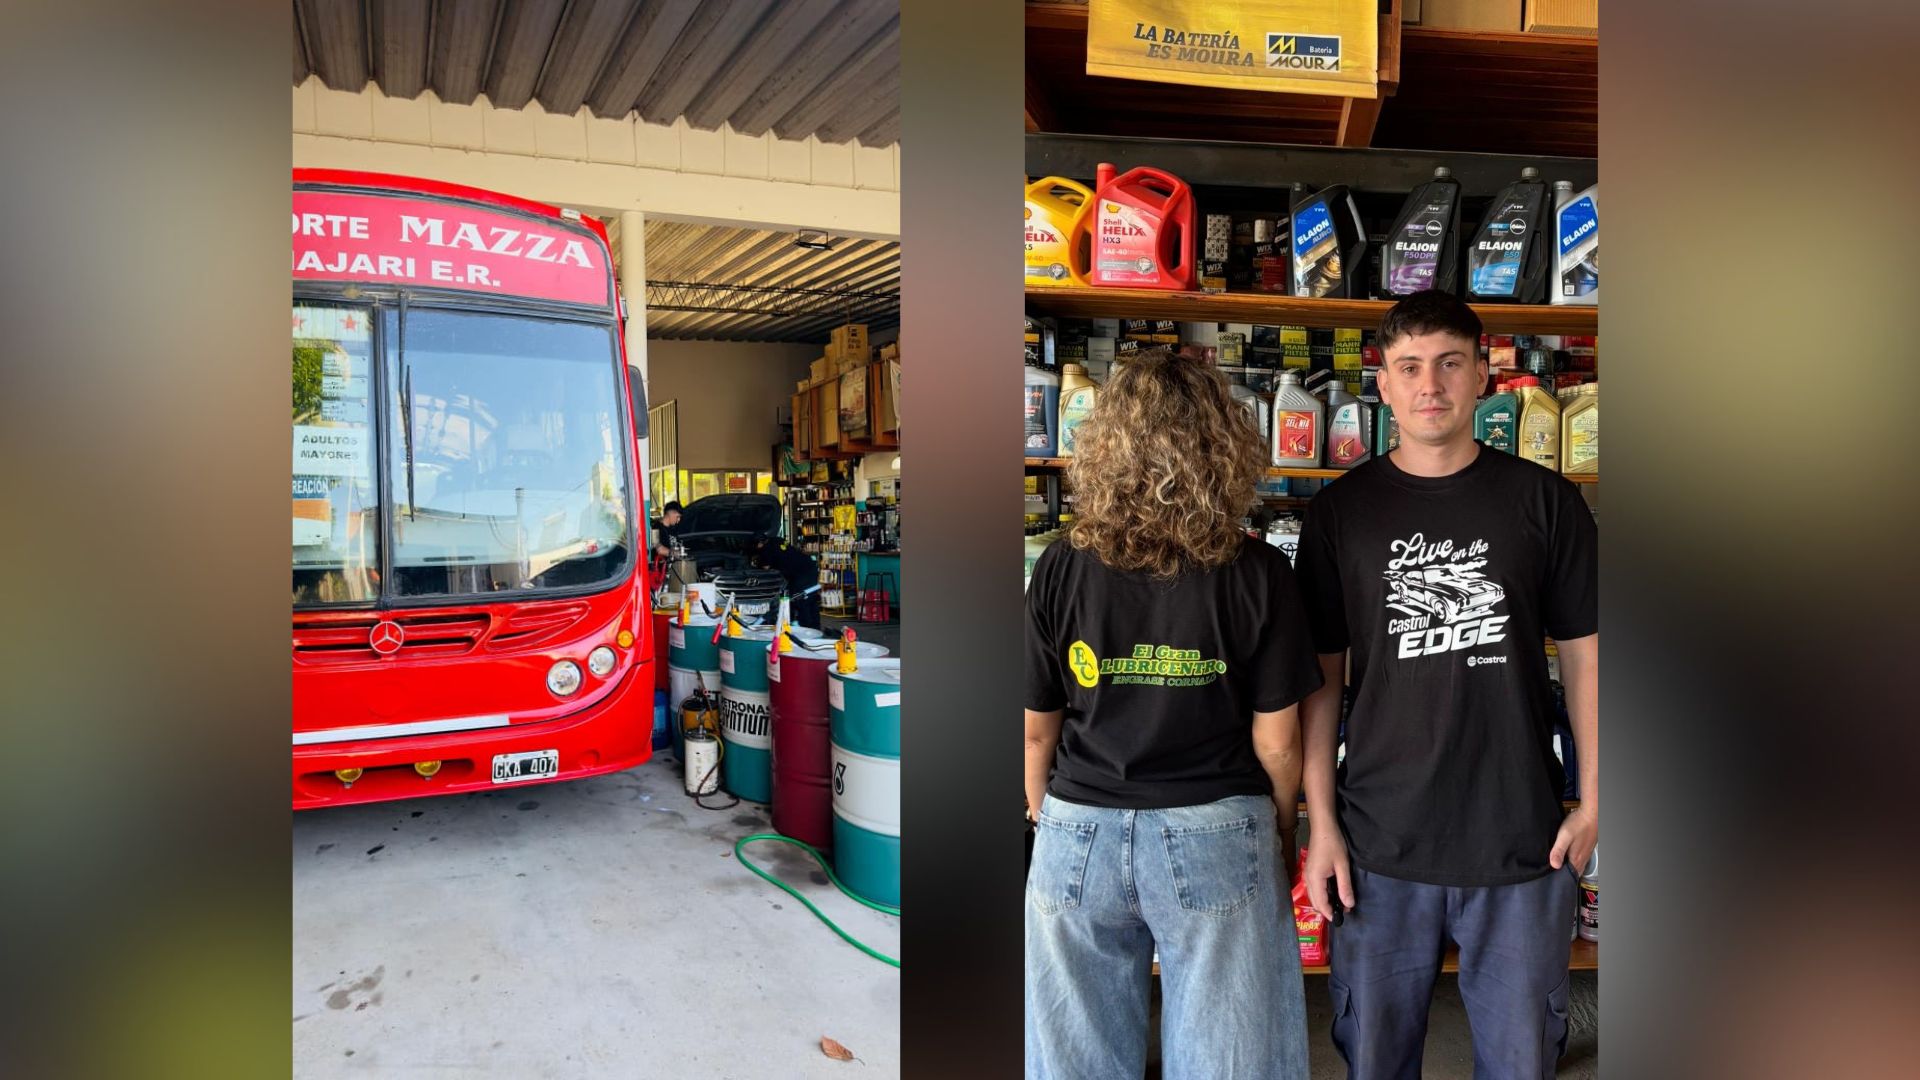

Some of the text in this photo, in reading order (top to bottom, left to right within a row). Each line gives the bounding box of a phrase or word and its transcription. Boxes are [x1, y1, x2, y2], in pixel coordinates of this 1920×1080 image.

[1134, 23, 1240, 49] LA BATERÍA
[1147, 43, 1255, 67] ES MOURA
[1269, 55, 1340, 71] MOURA
[1103, 226, 1146, 237] HELIX
[1103, 236, 1121, 244] HX3
[1297, 219, 1330, 245] ELAION
[1563, 219, 1596, 246] ELAION
[400, 214, 595, 269] MAZZA
[1395, 241, 1439, 252] ELAION
[1478, 241, 1522, 251] ELAION
[431, 260, 501, 286] E.R.
[1156, 320, 1174, 329] WIX
[1120, 340, 1138, 351] WIX
[302, 434, 358, 446] ADULTOS
[300, 450, 359, 460] MAYORES
[1388, 532, 1489, 570] Live on the
[1388, 613, 1431, 635] Castrol
[1398, 615, 1510, 659] EDGE
[1133, 644, 1200, 660] El Gran
[1477, 656, 1507, 664] Castrol
[1101, 658, 1227, 676] LUBRICENTRO
[495, 757, 557, 778] GKA 407
